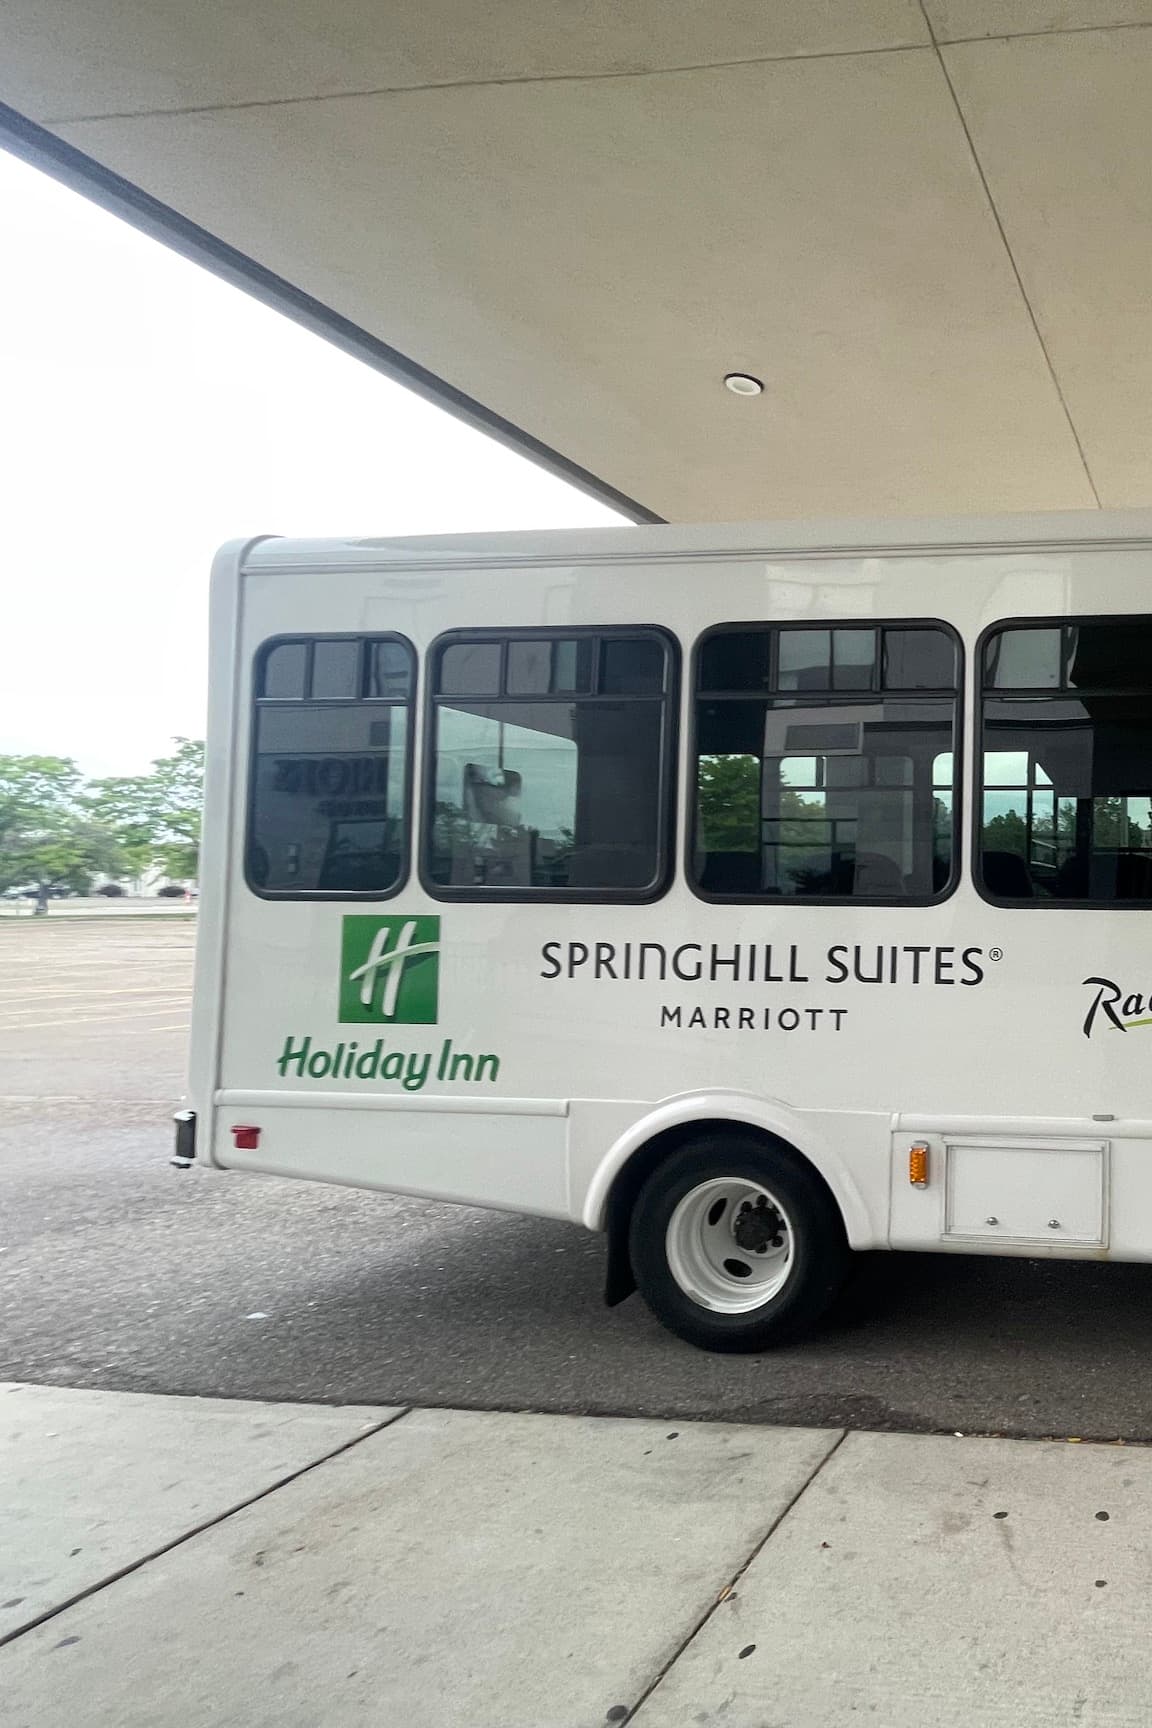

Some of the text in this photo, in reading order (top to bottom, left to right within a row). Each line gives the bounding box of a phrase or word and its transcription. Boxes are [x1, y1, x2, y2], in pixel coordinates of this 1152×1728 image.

[540, 942, 809, 983] SPRINGHILL
[660, 1005, 848, 1032] MARRIOTT
[277, 1036, 501, 1091] Holiday Inn
